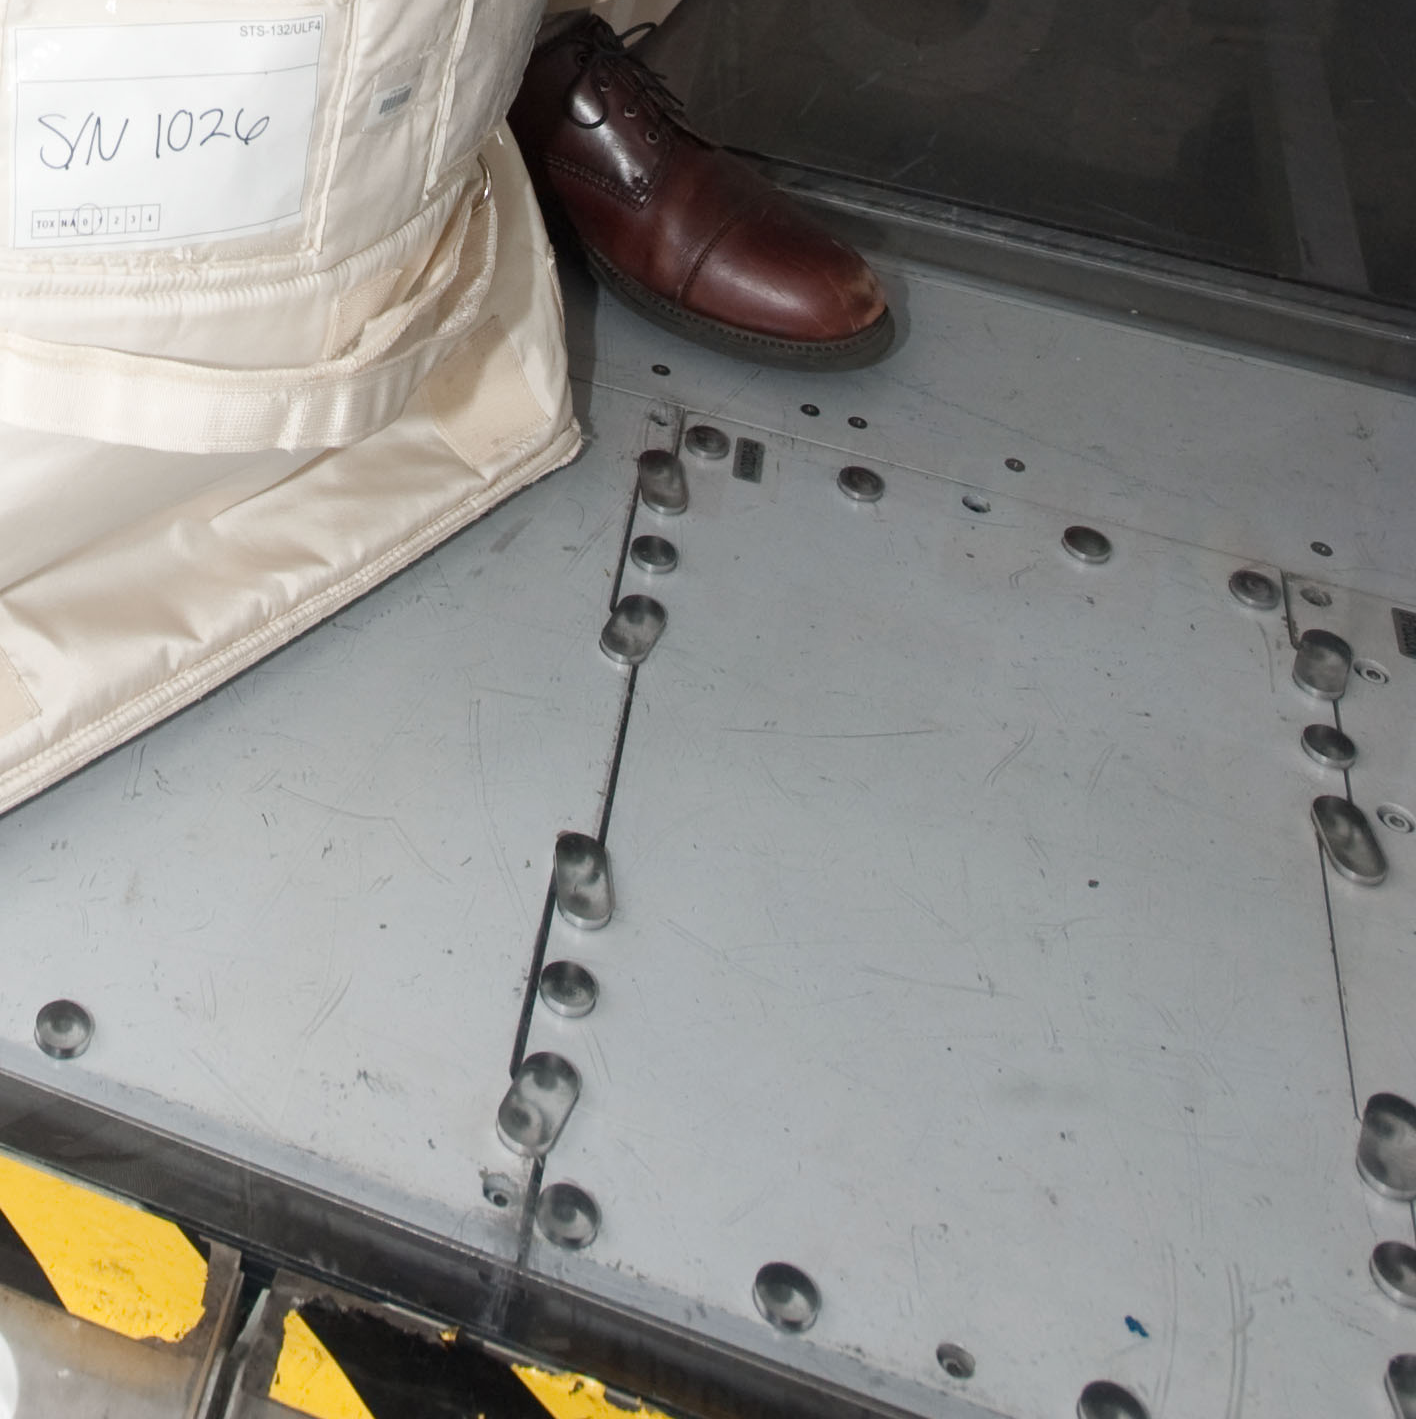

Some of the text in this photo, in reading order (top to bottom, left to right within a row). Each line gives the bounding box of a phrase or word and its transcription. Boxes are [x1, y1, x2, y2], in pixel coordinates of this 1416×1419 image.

[240, 20, 321, 37] STS-132/ULF4
[155, 108, 270, 159] 1026
[37, 219, 55, 229] TOX
